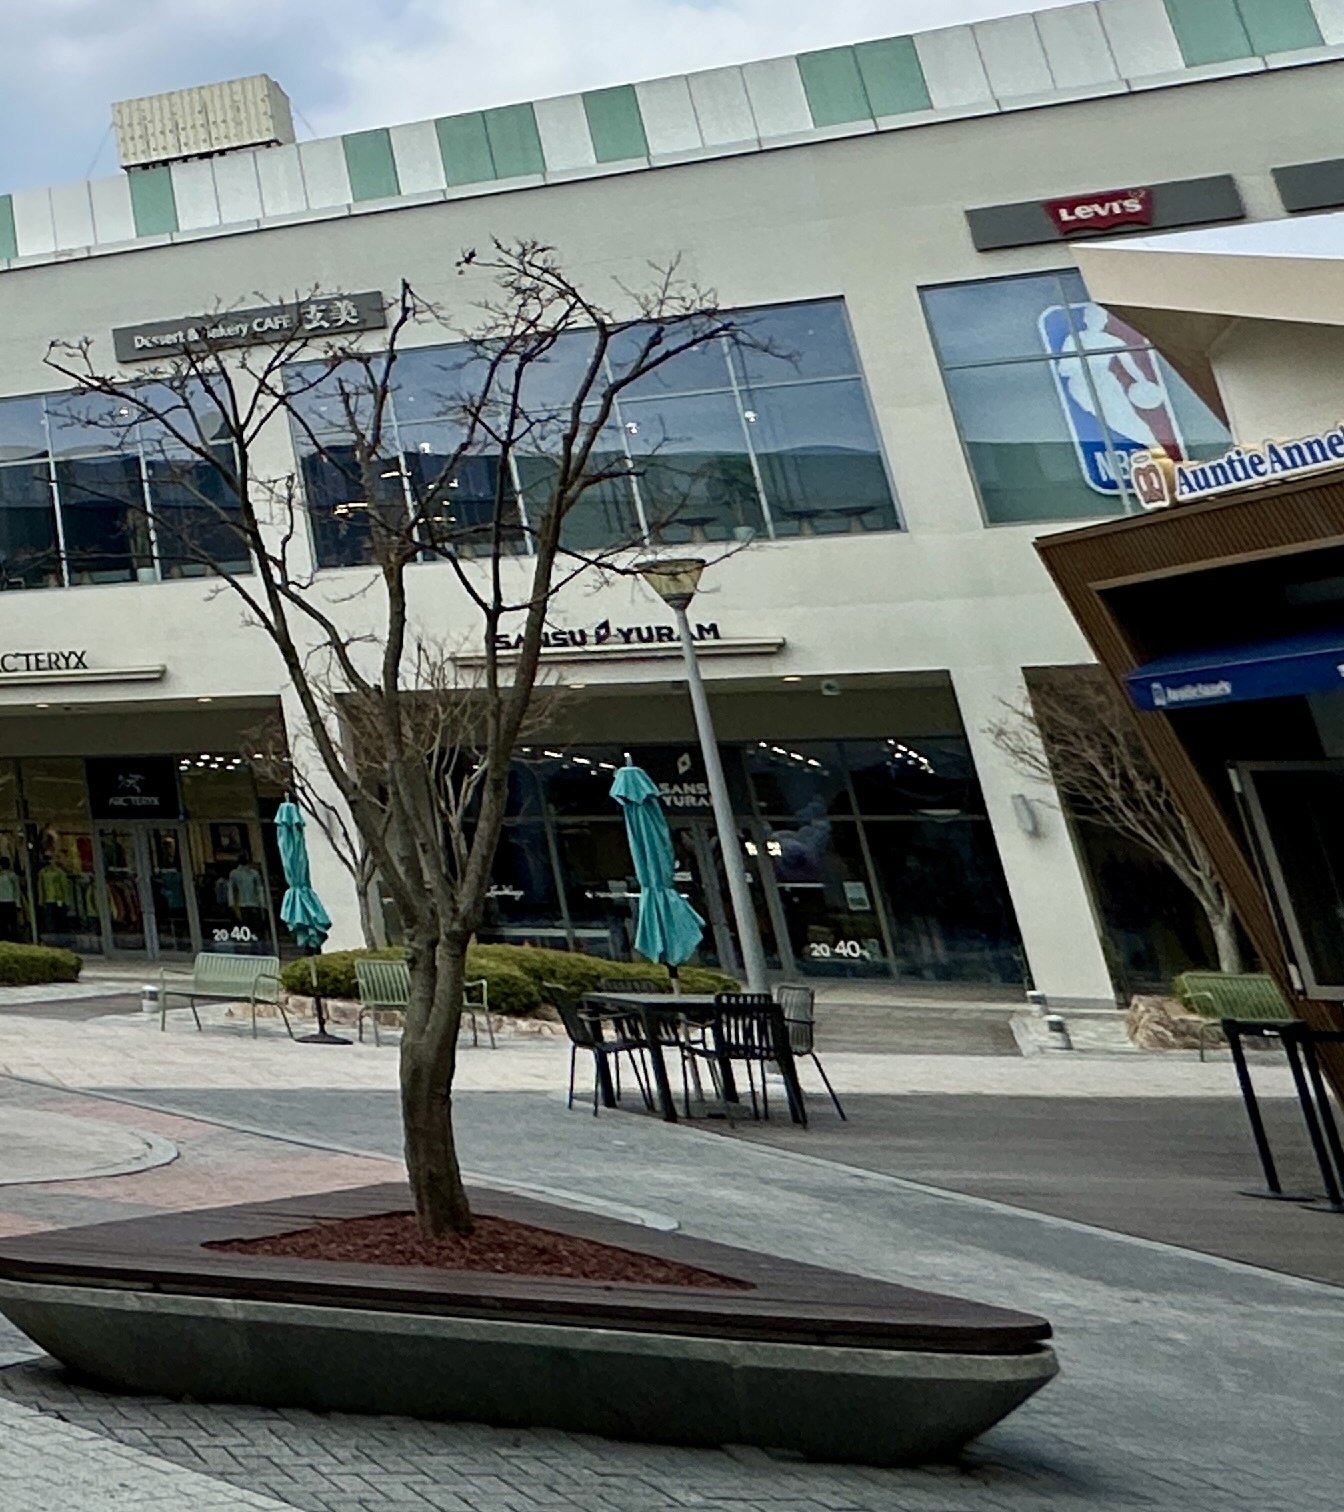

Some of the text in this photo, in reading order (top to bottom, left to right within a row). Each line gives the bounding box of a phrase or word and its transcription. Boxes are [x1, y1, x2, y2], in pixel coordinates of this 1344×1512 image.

[202, 322, 250, 339] akery
[252, 313, 292, 333] CAFE
[1094, 448, 1136, 482] NB
[1177, 448, 1269, 496] Auntie
[658, 782, 709, 796] SANS
